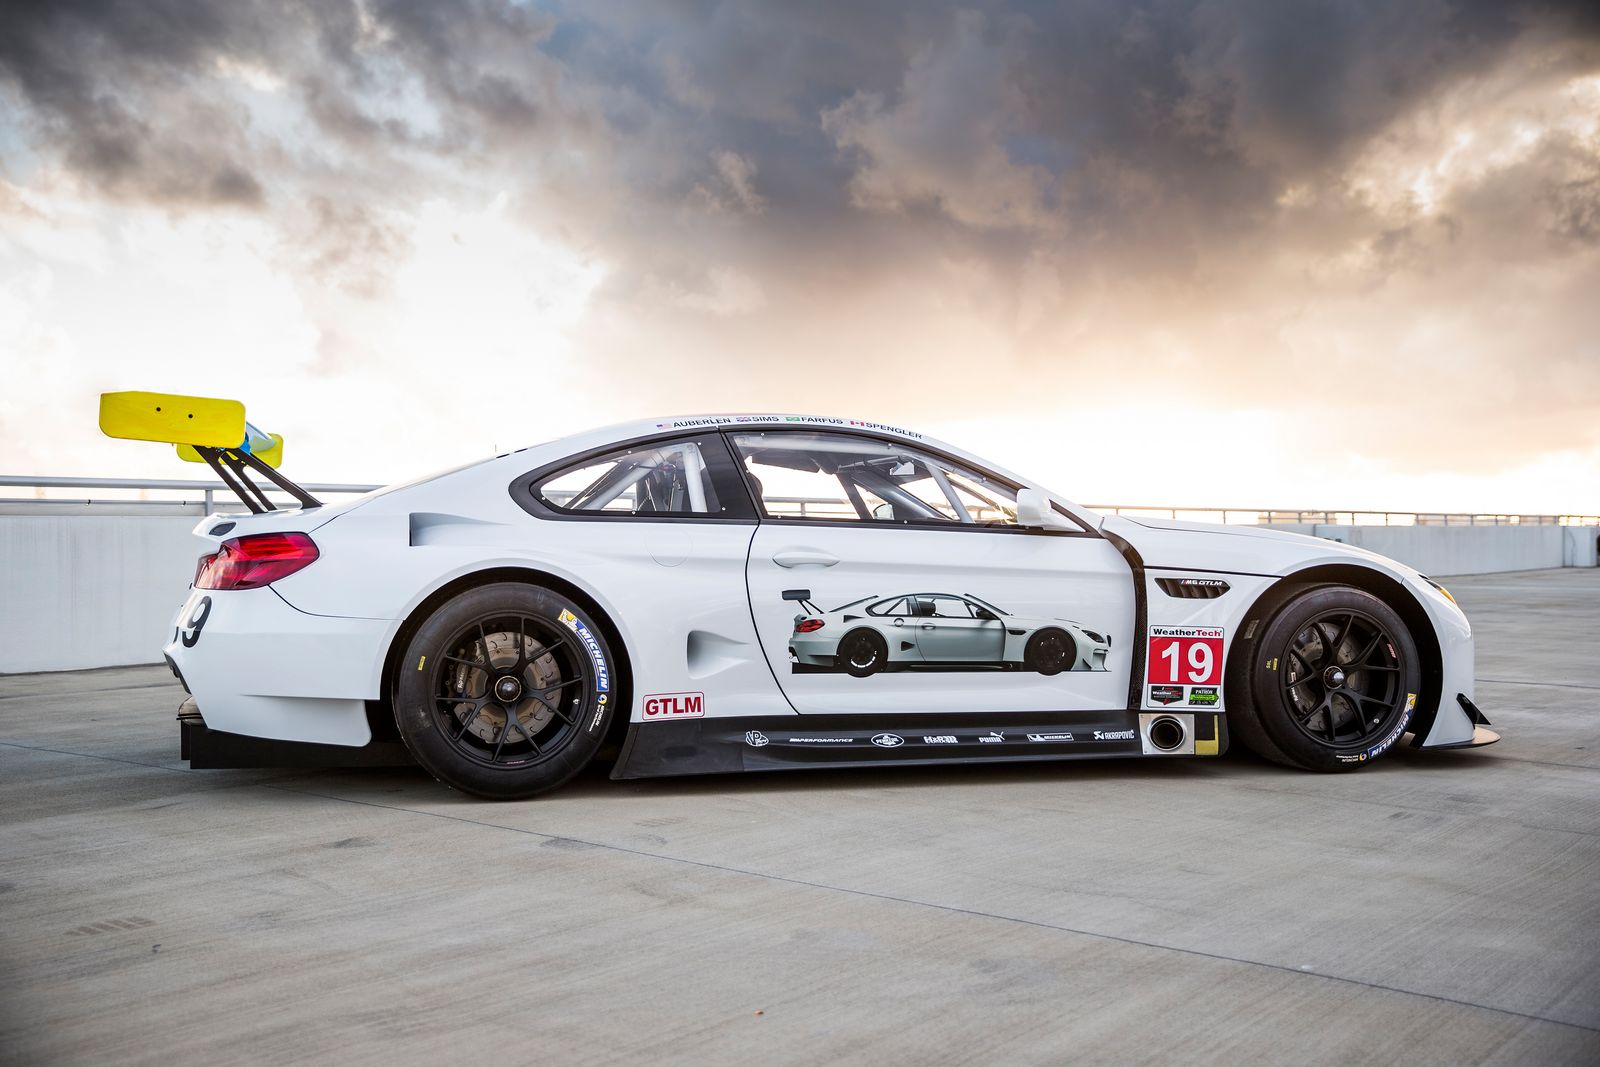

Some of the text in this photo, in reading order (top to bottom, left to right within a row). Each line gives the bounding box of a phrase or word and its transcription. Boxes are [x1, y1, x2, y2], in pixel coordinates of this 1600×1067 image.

[673, 417, 731, 428] AUBERLEN
[801, 416, 844, 425] FARFUS
[865, 422, 923, 440] SPENGLER
[1153, 628, 1221, 637] WeatherTech
[579, 627, 608, 689] MICHELIN
[1161, 641, 1214, 683] 19
[645, 696, 702, 716] GTLM
[1370, 713, 1409, 757] MICHELIN
